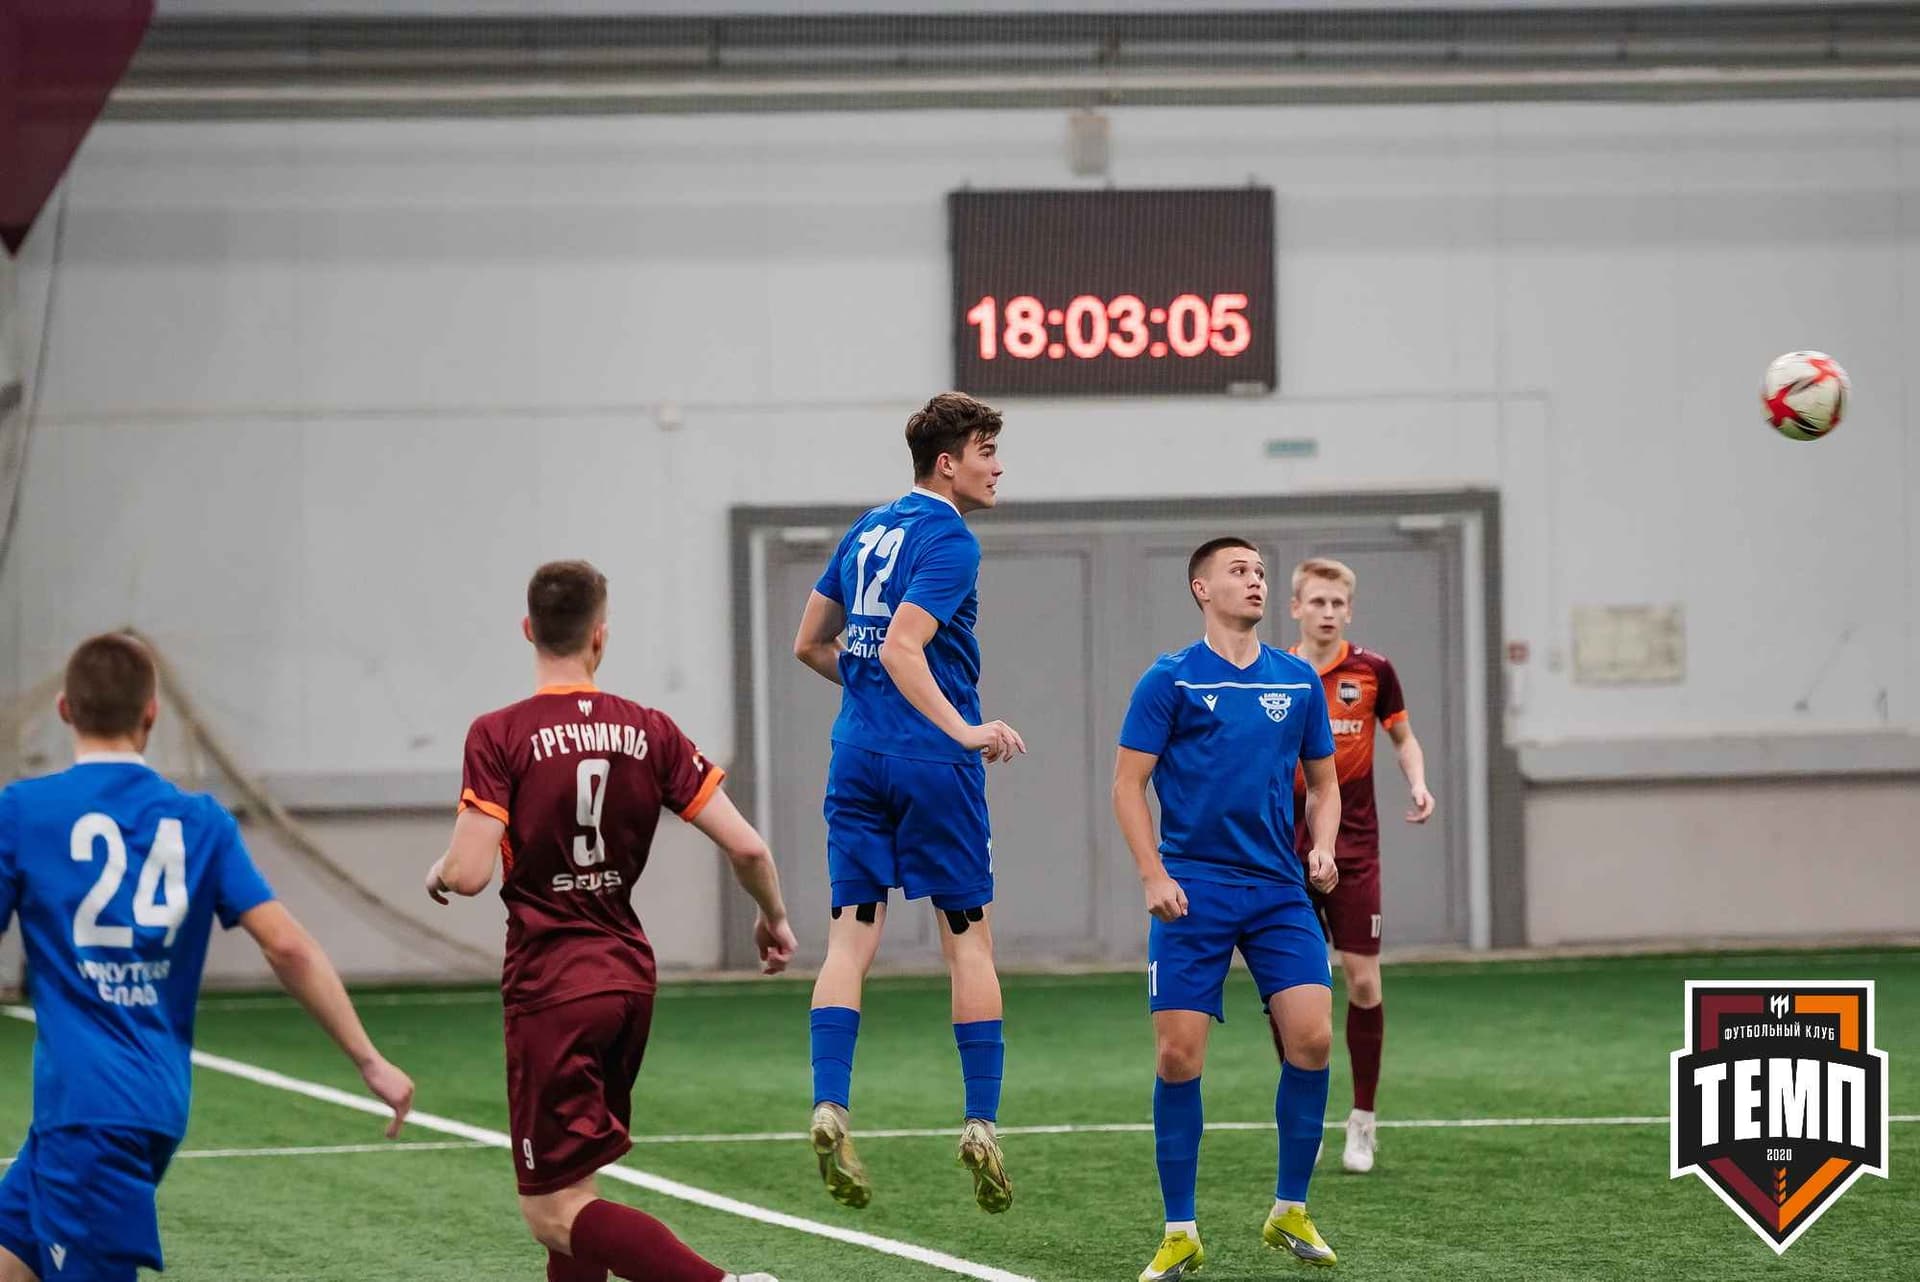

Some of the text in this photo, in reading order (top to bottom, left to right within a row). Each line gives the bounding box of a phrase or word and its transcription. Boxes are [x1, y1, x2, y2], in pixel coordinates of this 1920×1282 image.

[966, 293, 1251, 360] 18:03:05
[852, 524, 905, 617] 12
[572, 758, 611, 867] 9
[70, 812, 188, 948] 24
[522, 1138, 535, 1170] 9
